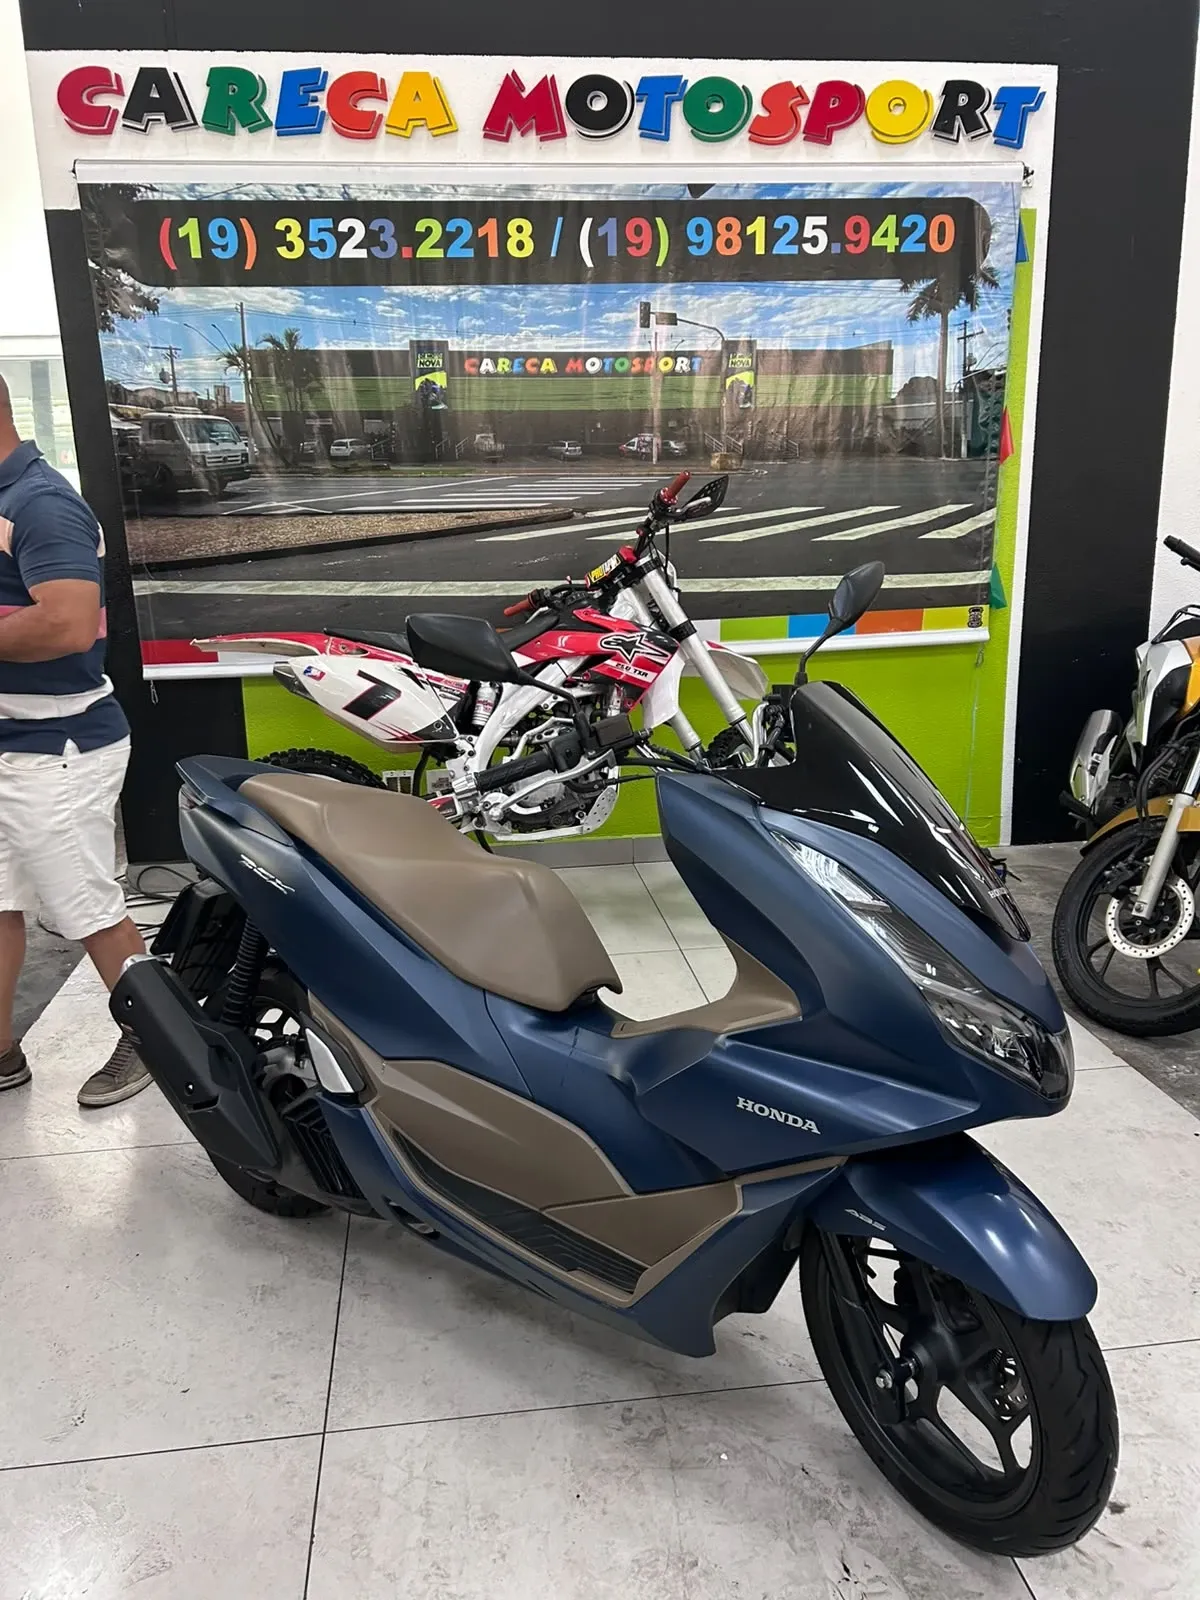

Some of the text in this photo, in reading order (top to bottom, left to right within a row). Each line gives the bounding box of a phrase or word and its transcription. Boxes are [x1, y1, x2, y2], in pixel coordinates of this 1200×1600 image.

[57, 66, 1046, 149] CARECA MOTOSPORT
[159, 217, 258, 270] (19)
[275, 217, 535, 260] 3523.2218
[579, 217, 669, 267] (19)
[686, 214, 956, 257] 98125.9420
[464, 356, 703, 375] CARECA MOTOSPORT
[736, 1096, 821, 1135] HONDA
